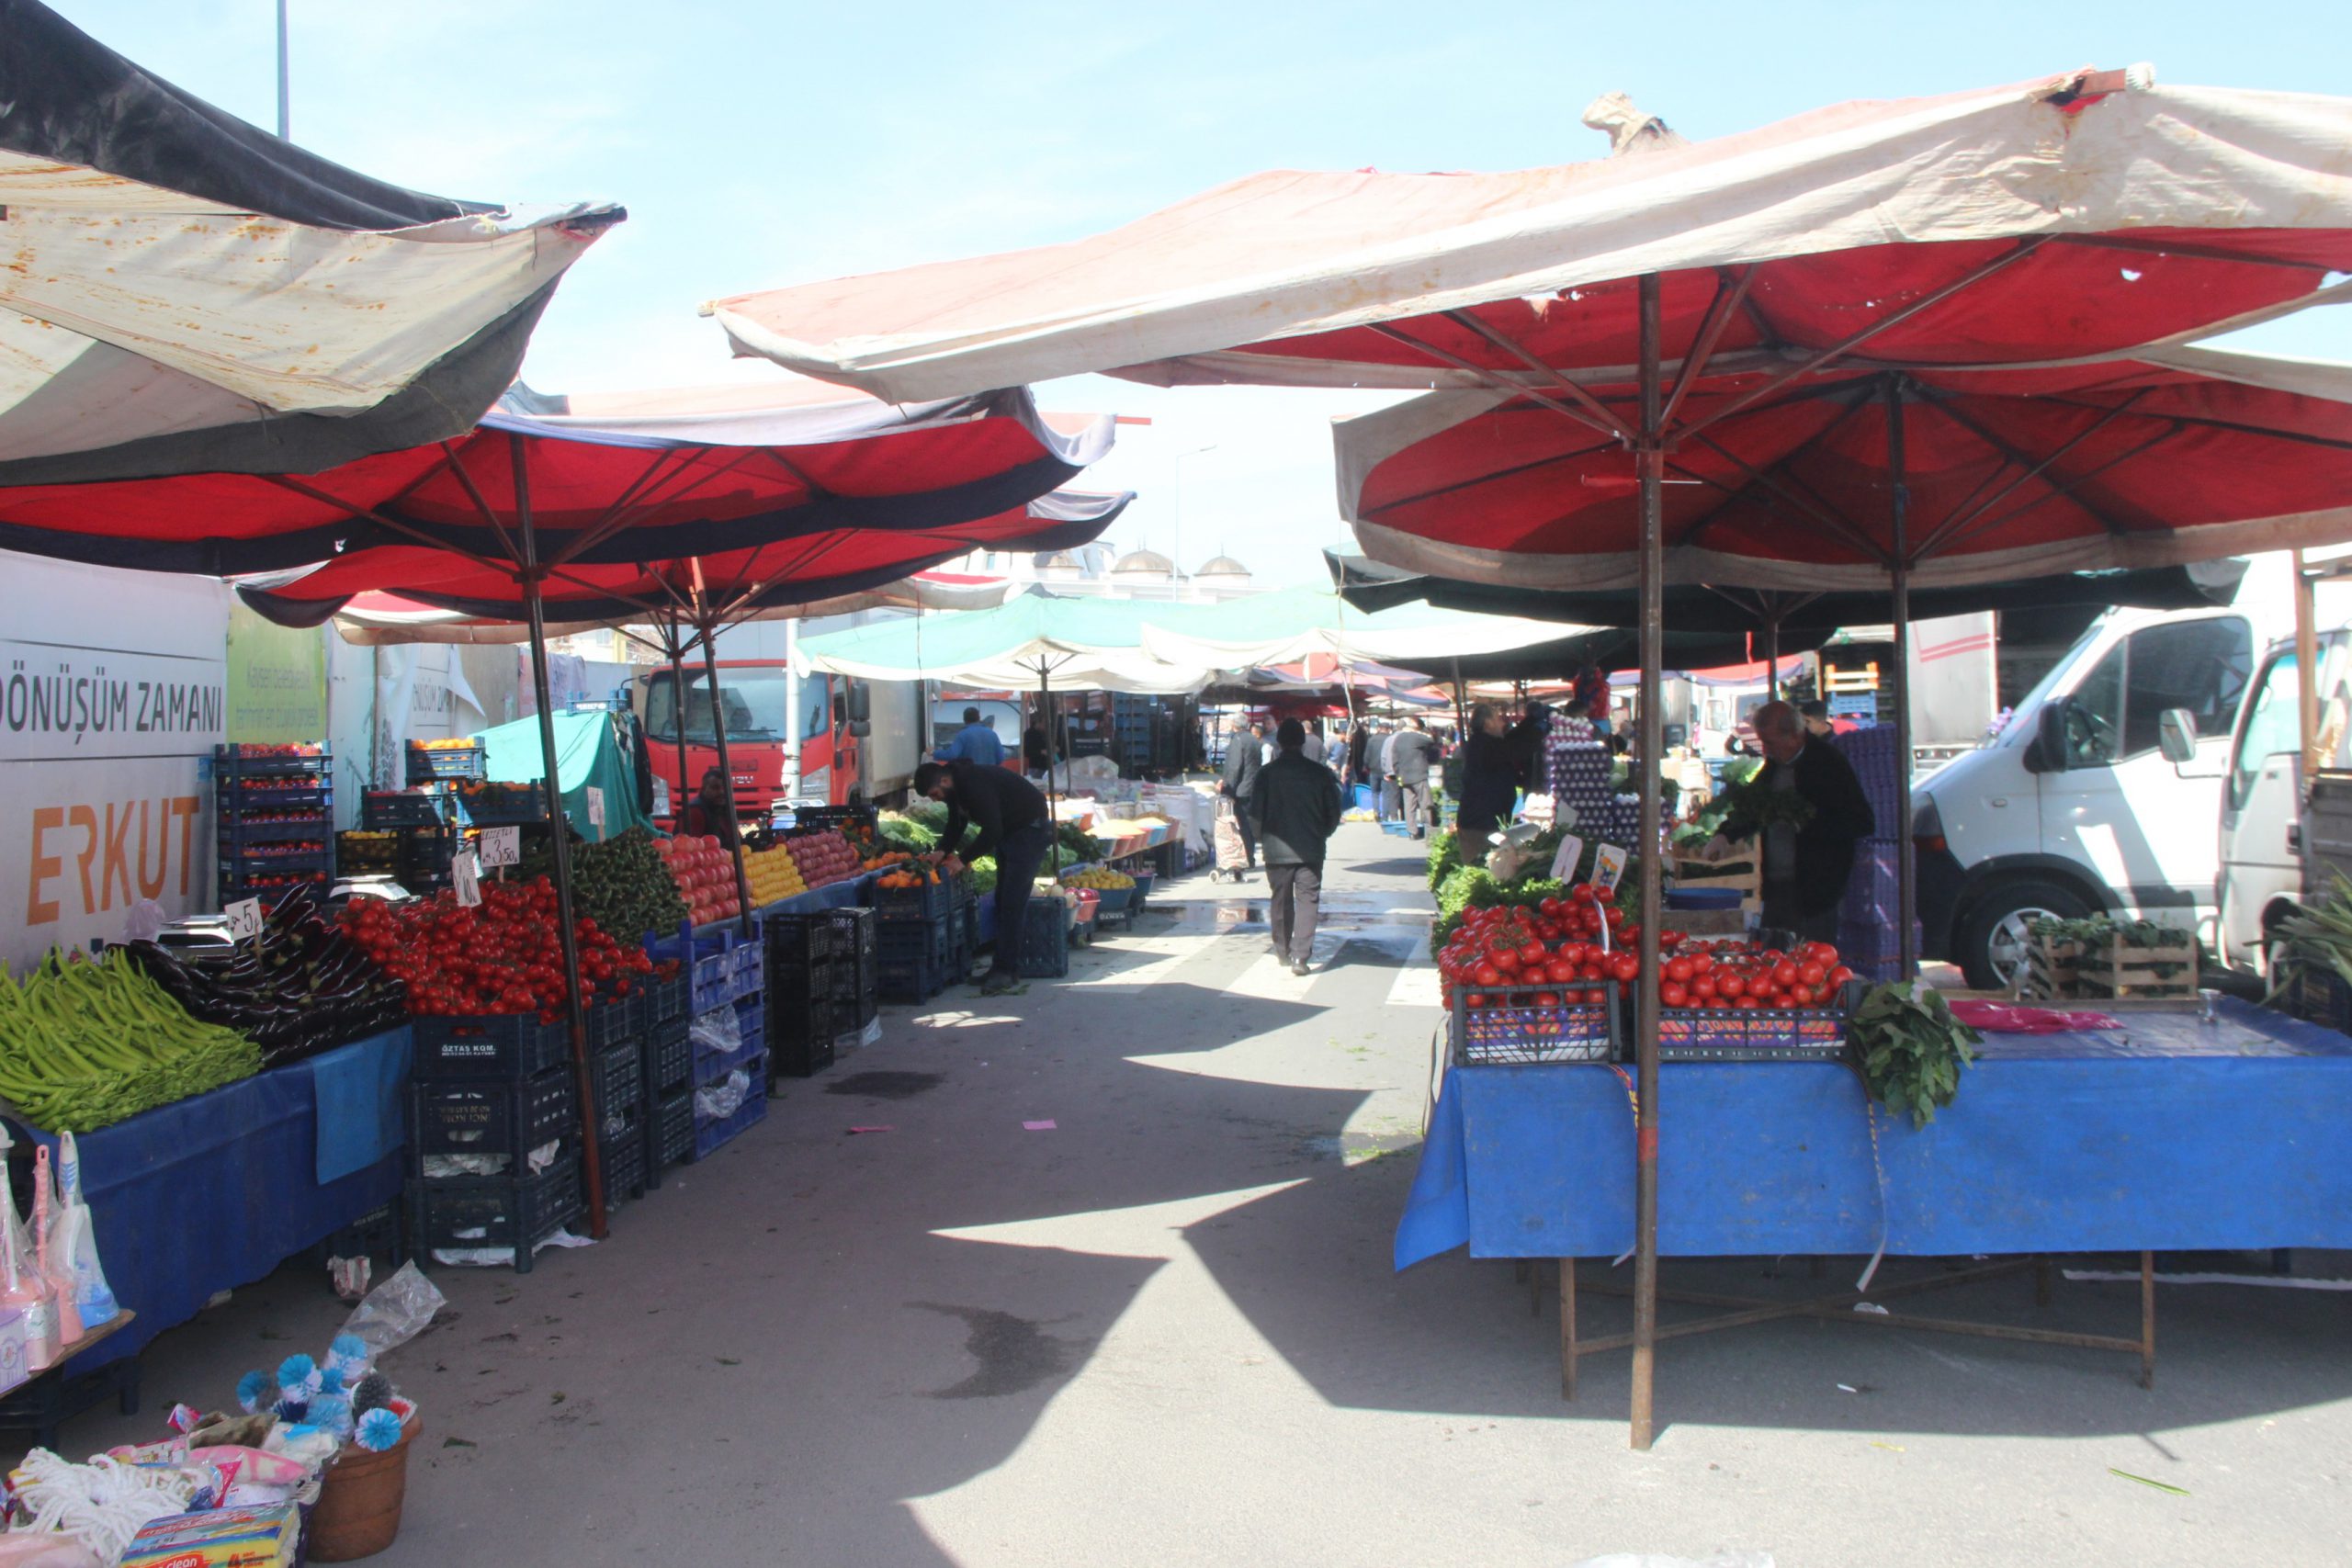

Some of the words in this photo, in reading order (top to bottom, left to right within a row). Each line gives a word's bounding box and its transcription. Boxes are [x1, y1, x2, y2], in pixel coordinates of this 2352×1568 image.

[0, 660, 128, 745] ÖNÜŞÜM
[136, 682, 221, 732] ZAMANI
[27, 795, 199, 926] ERKUT
[243, 903, 254, 932] 5
[166, 1557, 198, 1568] clean
